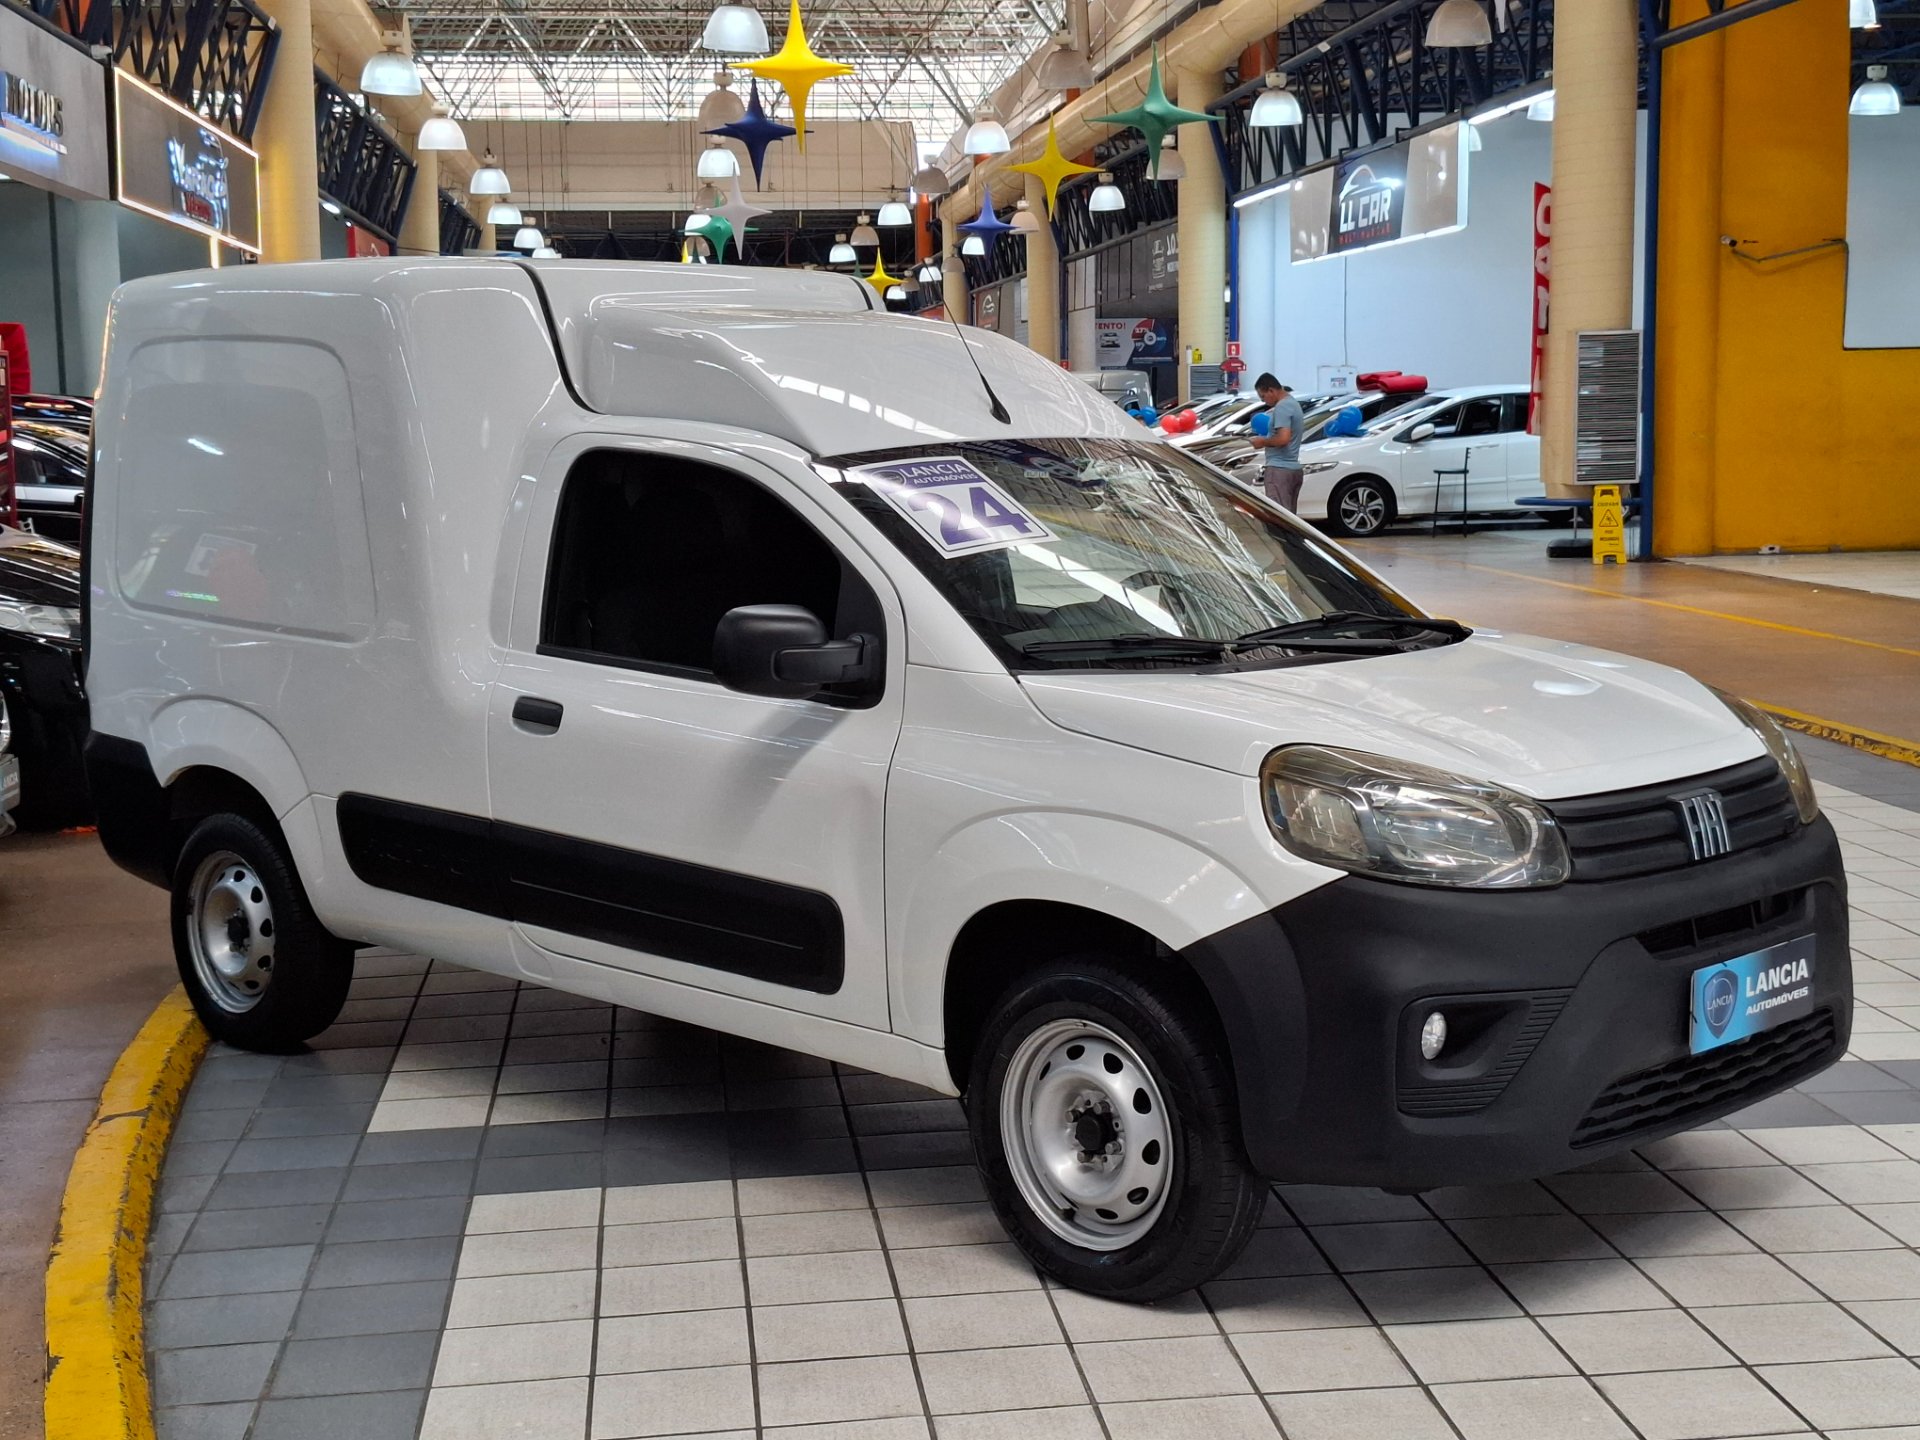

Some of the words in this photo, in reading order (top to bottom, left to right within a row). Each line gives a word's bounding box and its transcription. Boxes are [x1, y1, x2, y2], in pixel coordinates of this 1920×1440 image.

[1358, 188, 1392, 228] CAR
[901, 463, 970, 478] LANCIA
[913, 473, 978, 485] AUTOMÓVEIS
[907, 487, 1032, 545] 24
[1680, 794, 1732, 861] FIAT
[1746, 957, 1808, 998] LANCIA
[1707, 994, 1733, 1012] LANCIA
[1745, 986, 1809, 1016] AUTOMÓVEIS
